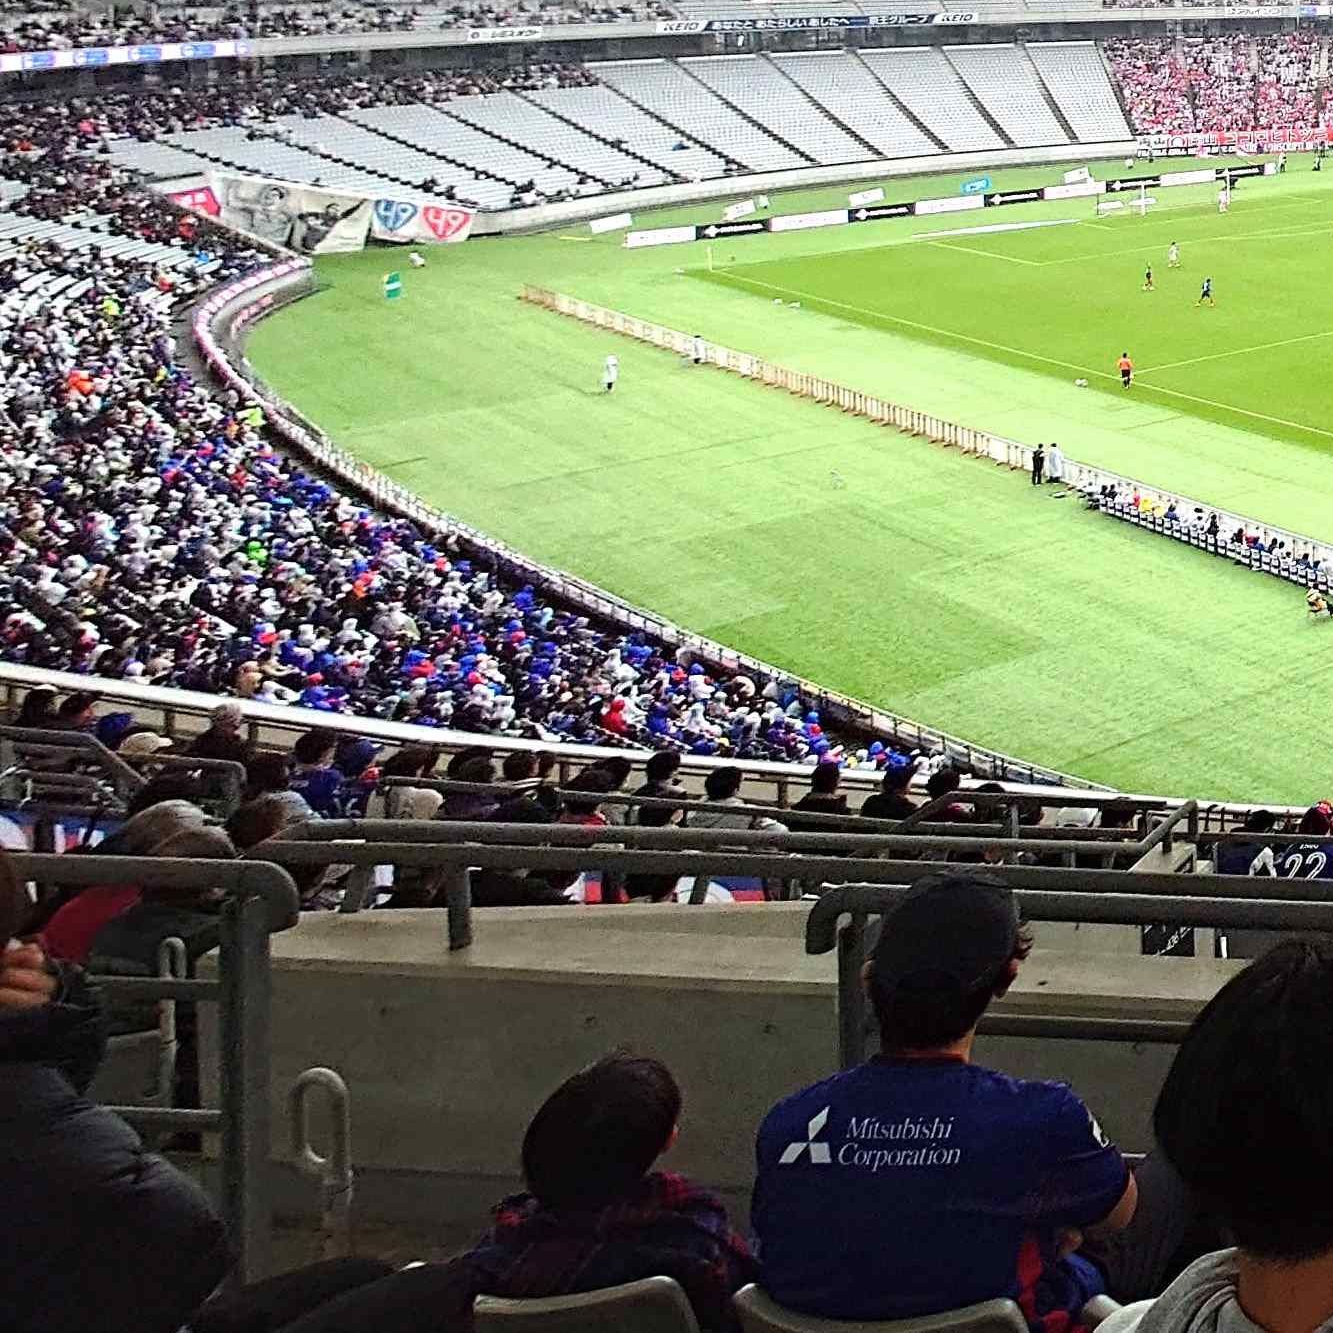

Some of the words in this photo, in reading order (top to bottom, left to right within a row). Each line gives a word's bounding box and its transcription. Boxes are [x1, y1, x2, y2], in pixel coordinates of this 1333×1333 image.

[663, 21, 700, 32] KEIO
[941, 13, 974, 23] KEIO
[846, 1116, 955, 1139] Mitsubishi
[838, 1142, 962, 1172] Corporation
